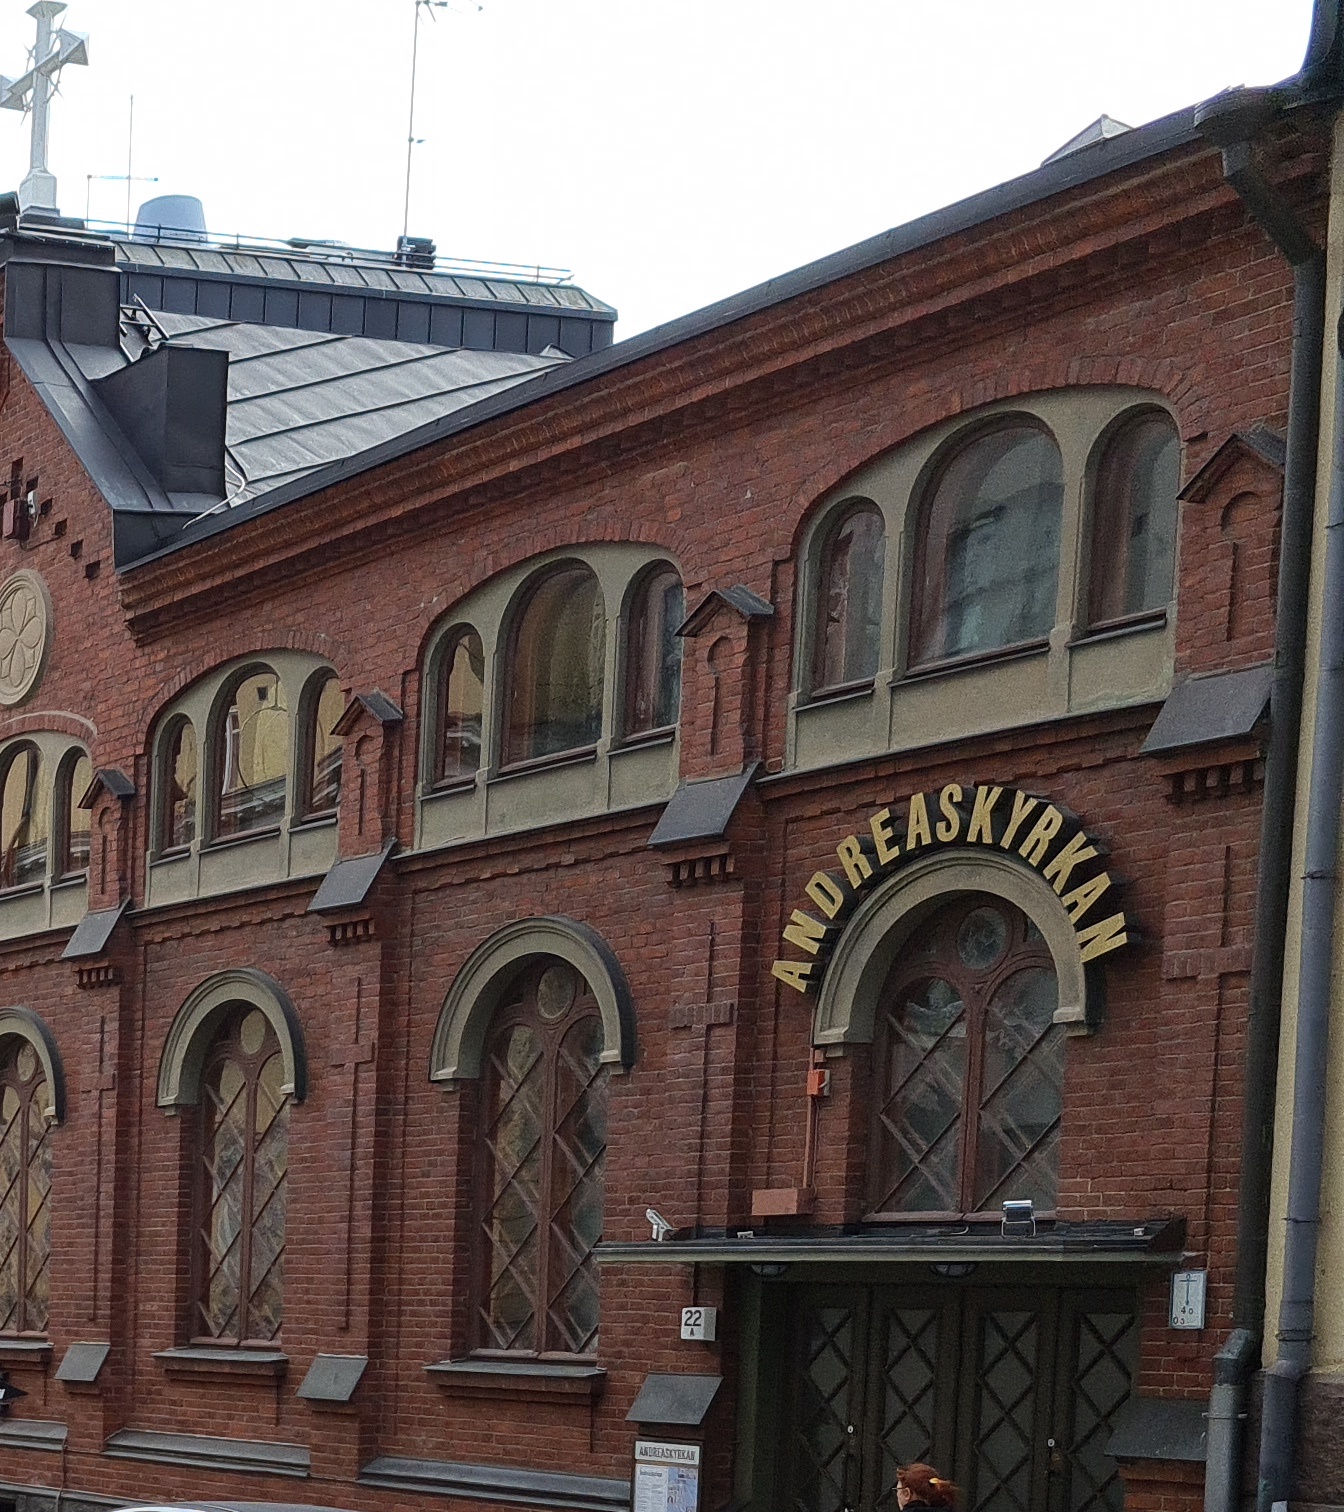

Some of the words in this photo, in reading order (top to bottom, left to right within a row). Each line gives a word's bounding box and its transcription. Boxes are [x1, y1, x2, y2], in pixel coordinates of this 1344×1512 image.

[771, 783, 1127, 993] ANDREASKYRKAN
[683, 1309, 702, 1327] 22
[689, 1327, 695, 1337] A
